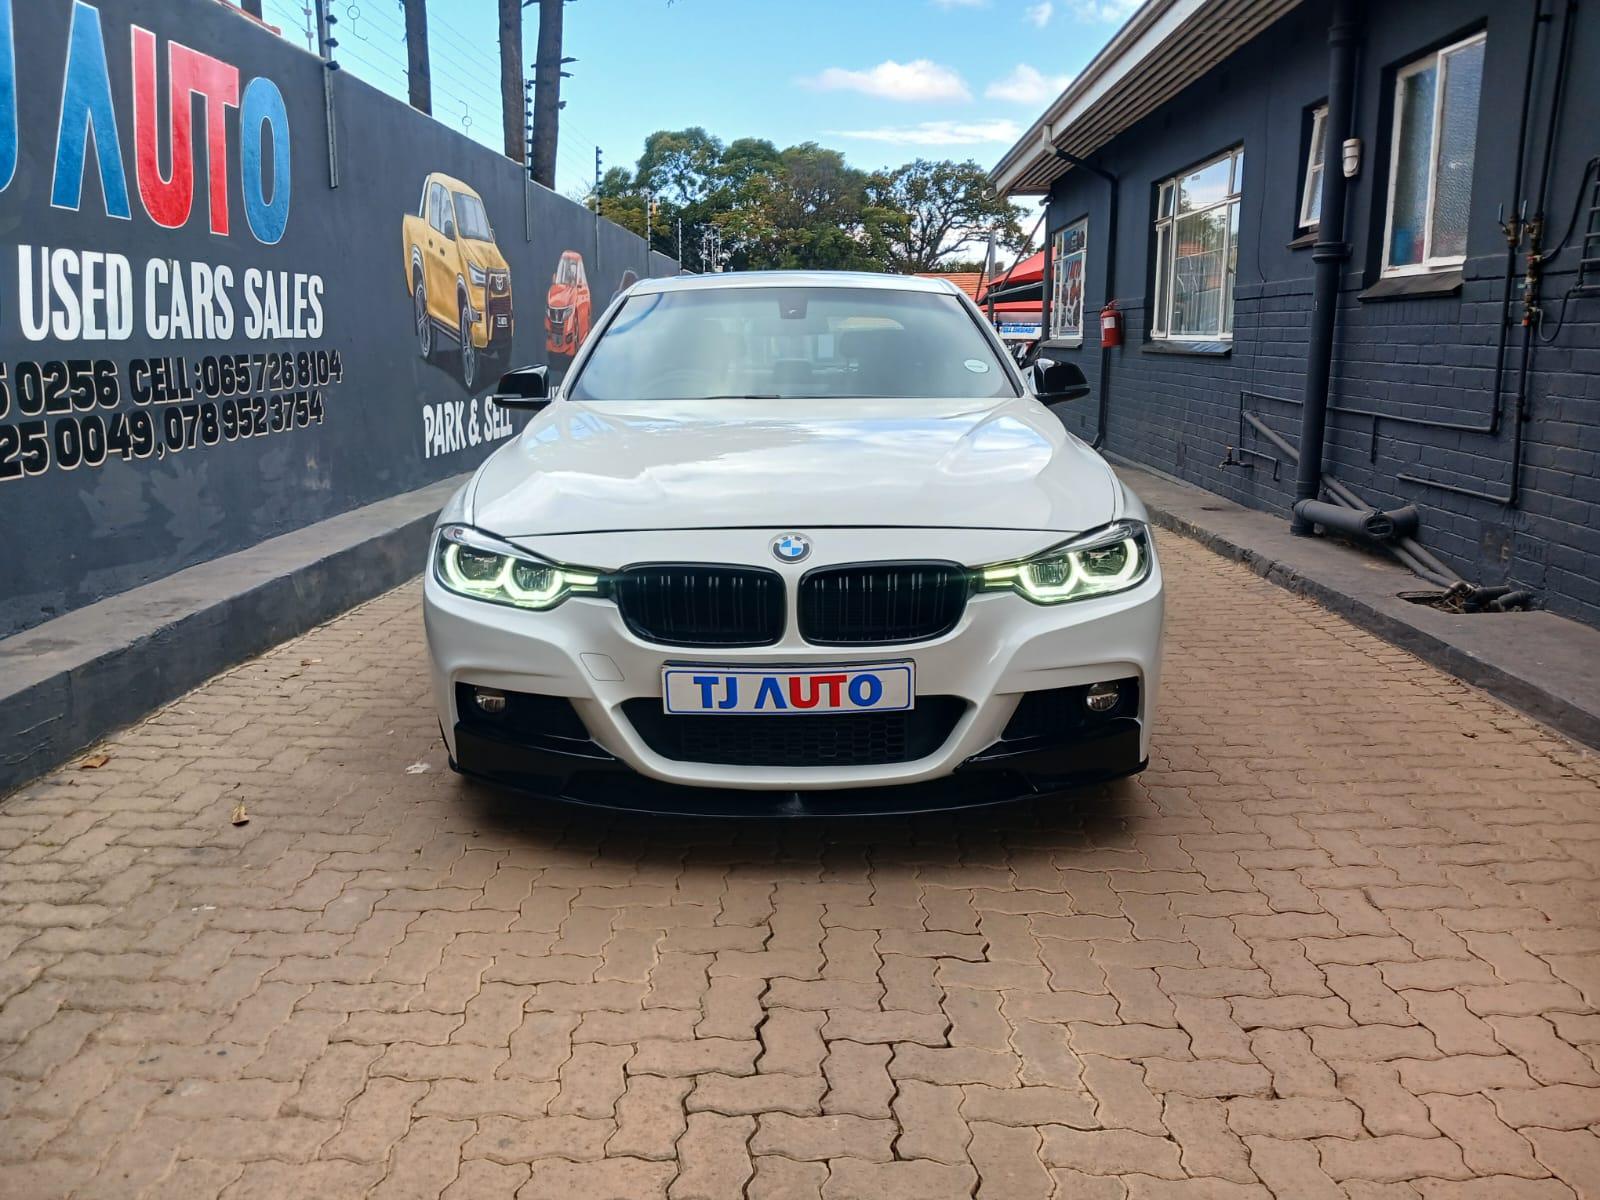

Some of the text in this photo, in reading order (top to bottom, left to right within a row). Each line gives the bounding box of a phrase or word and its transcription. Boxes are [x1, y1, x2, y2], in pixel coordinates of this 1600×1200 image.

[50, 0, 290, 245] AUTO
[18, 244, 324, 341] USED CARS SALES
[15, 359, 121, 417] 0256
[253, 352, 296, 393] 726
[297, 349, 343, 388] 8104
[222, 396, 269, 442] 952
[269, 390, 324, 433] 3754
[422, 395, 513, 459] PARK & SELL
[692, 673, 883, 710] TJ AUTO
